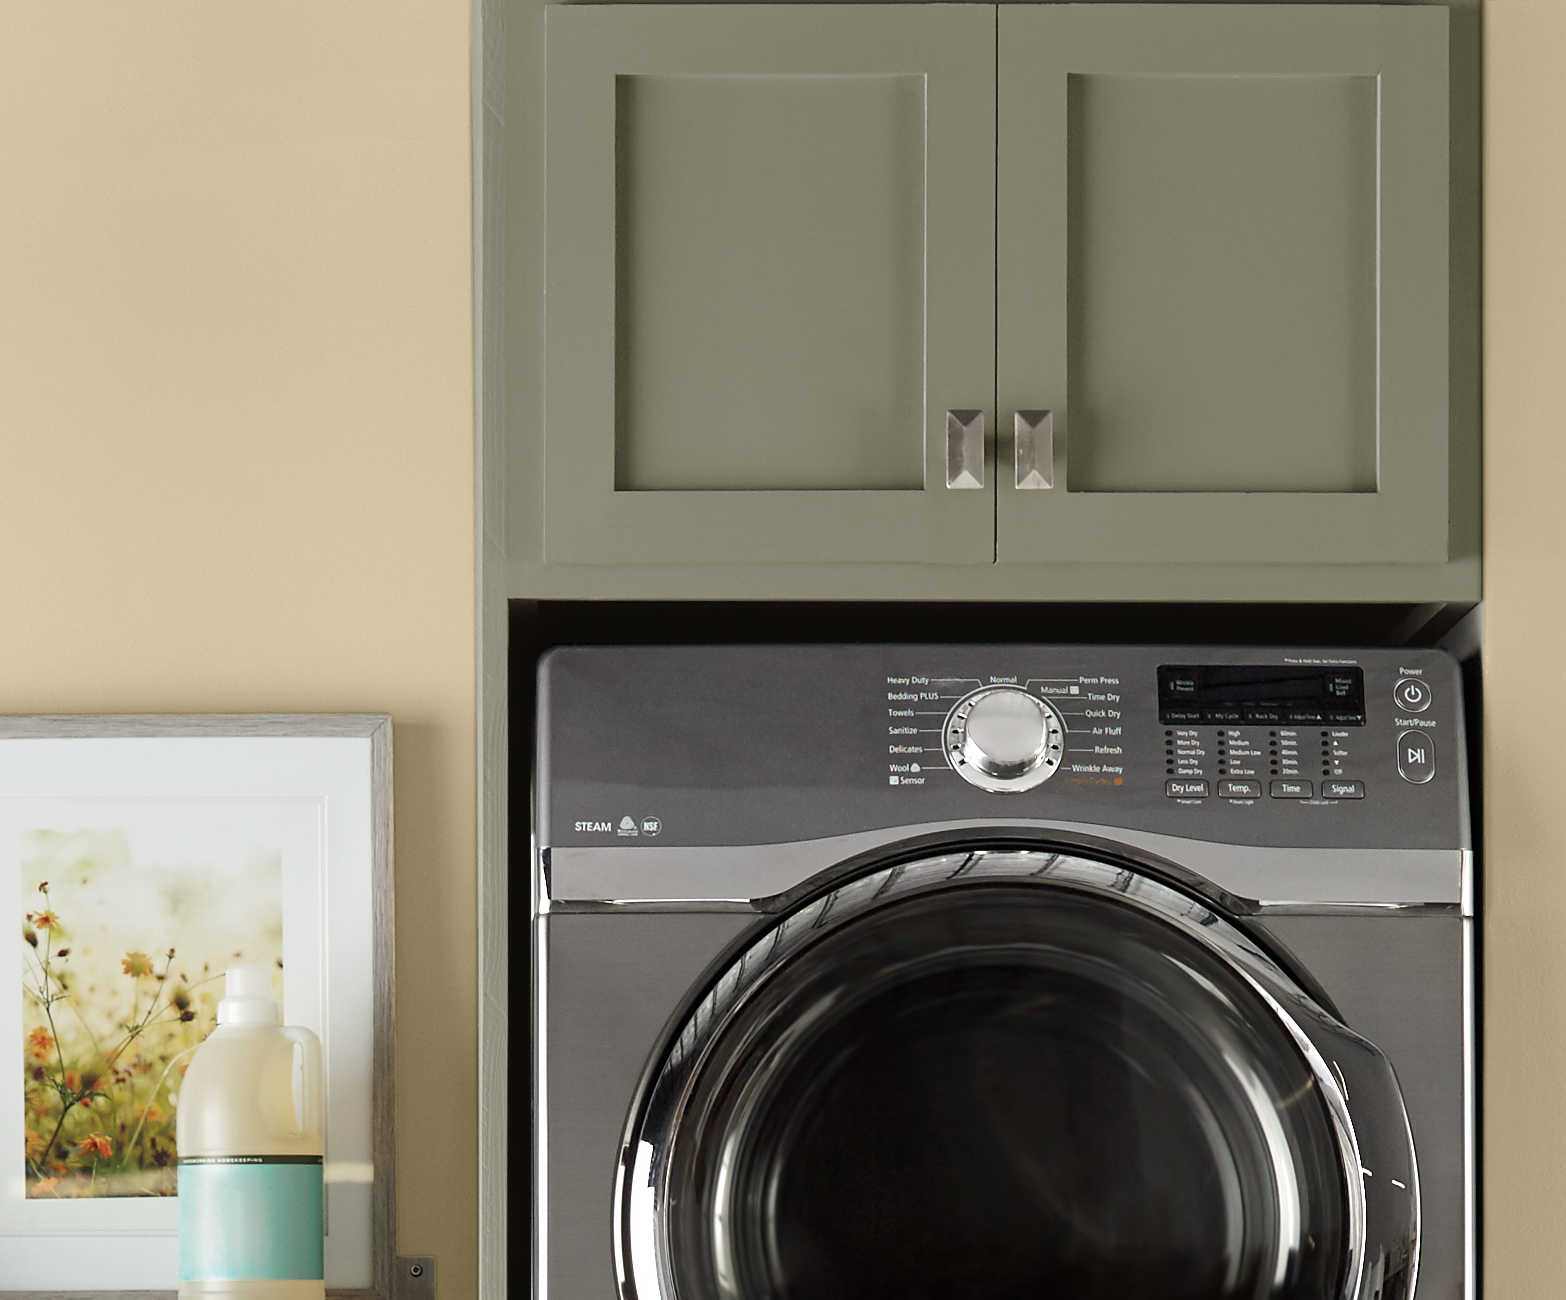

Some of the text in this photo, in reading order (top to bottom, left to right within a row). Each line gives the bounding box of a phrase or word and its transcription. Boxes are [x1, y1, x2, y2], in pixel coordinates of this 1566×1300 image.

[1399, 667, 1423, 675] Power
[887, 676, 929, 686] Heavy Duty
[989, 675, 1017, 684] Normal
[1100, 677, 1119, 685] Press
[1040, 686, 1069, 694] Manual
[887, 692, 919, 702] Bedding
[1087, 693, 1121, 702] Time Dry
[888, 709, 915, 717] Towels
[1085, 709, 1121, 719] Quick Dry
[1394, 718, 1436, 727] Start/Pause
[888, 726, 918, 735] Sanitize
[1092, 727, 1122, 735] Air Fluff
[1228, 730, 1240, 738] High
[889, 745, 923, 754] Delicates
[1094, 745, 1123, 754] Refresh
[889, 764, 910, 772] Wool
[1071, 764, 1123, 774] Wrinkle Away
[900, 777, 925, 785] Sensor
[1172, 783, 1204, 794] Dry Level
[1228, 784, 1251, 794] Temp.
[1282, 784, 1301, 793] Time
[1331, 784, 1355, 795] Signal
[575, 821, 612, 832] STEAM
[643, 821, 659, 832] NSF
